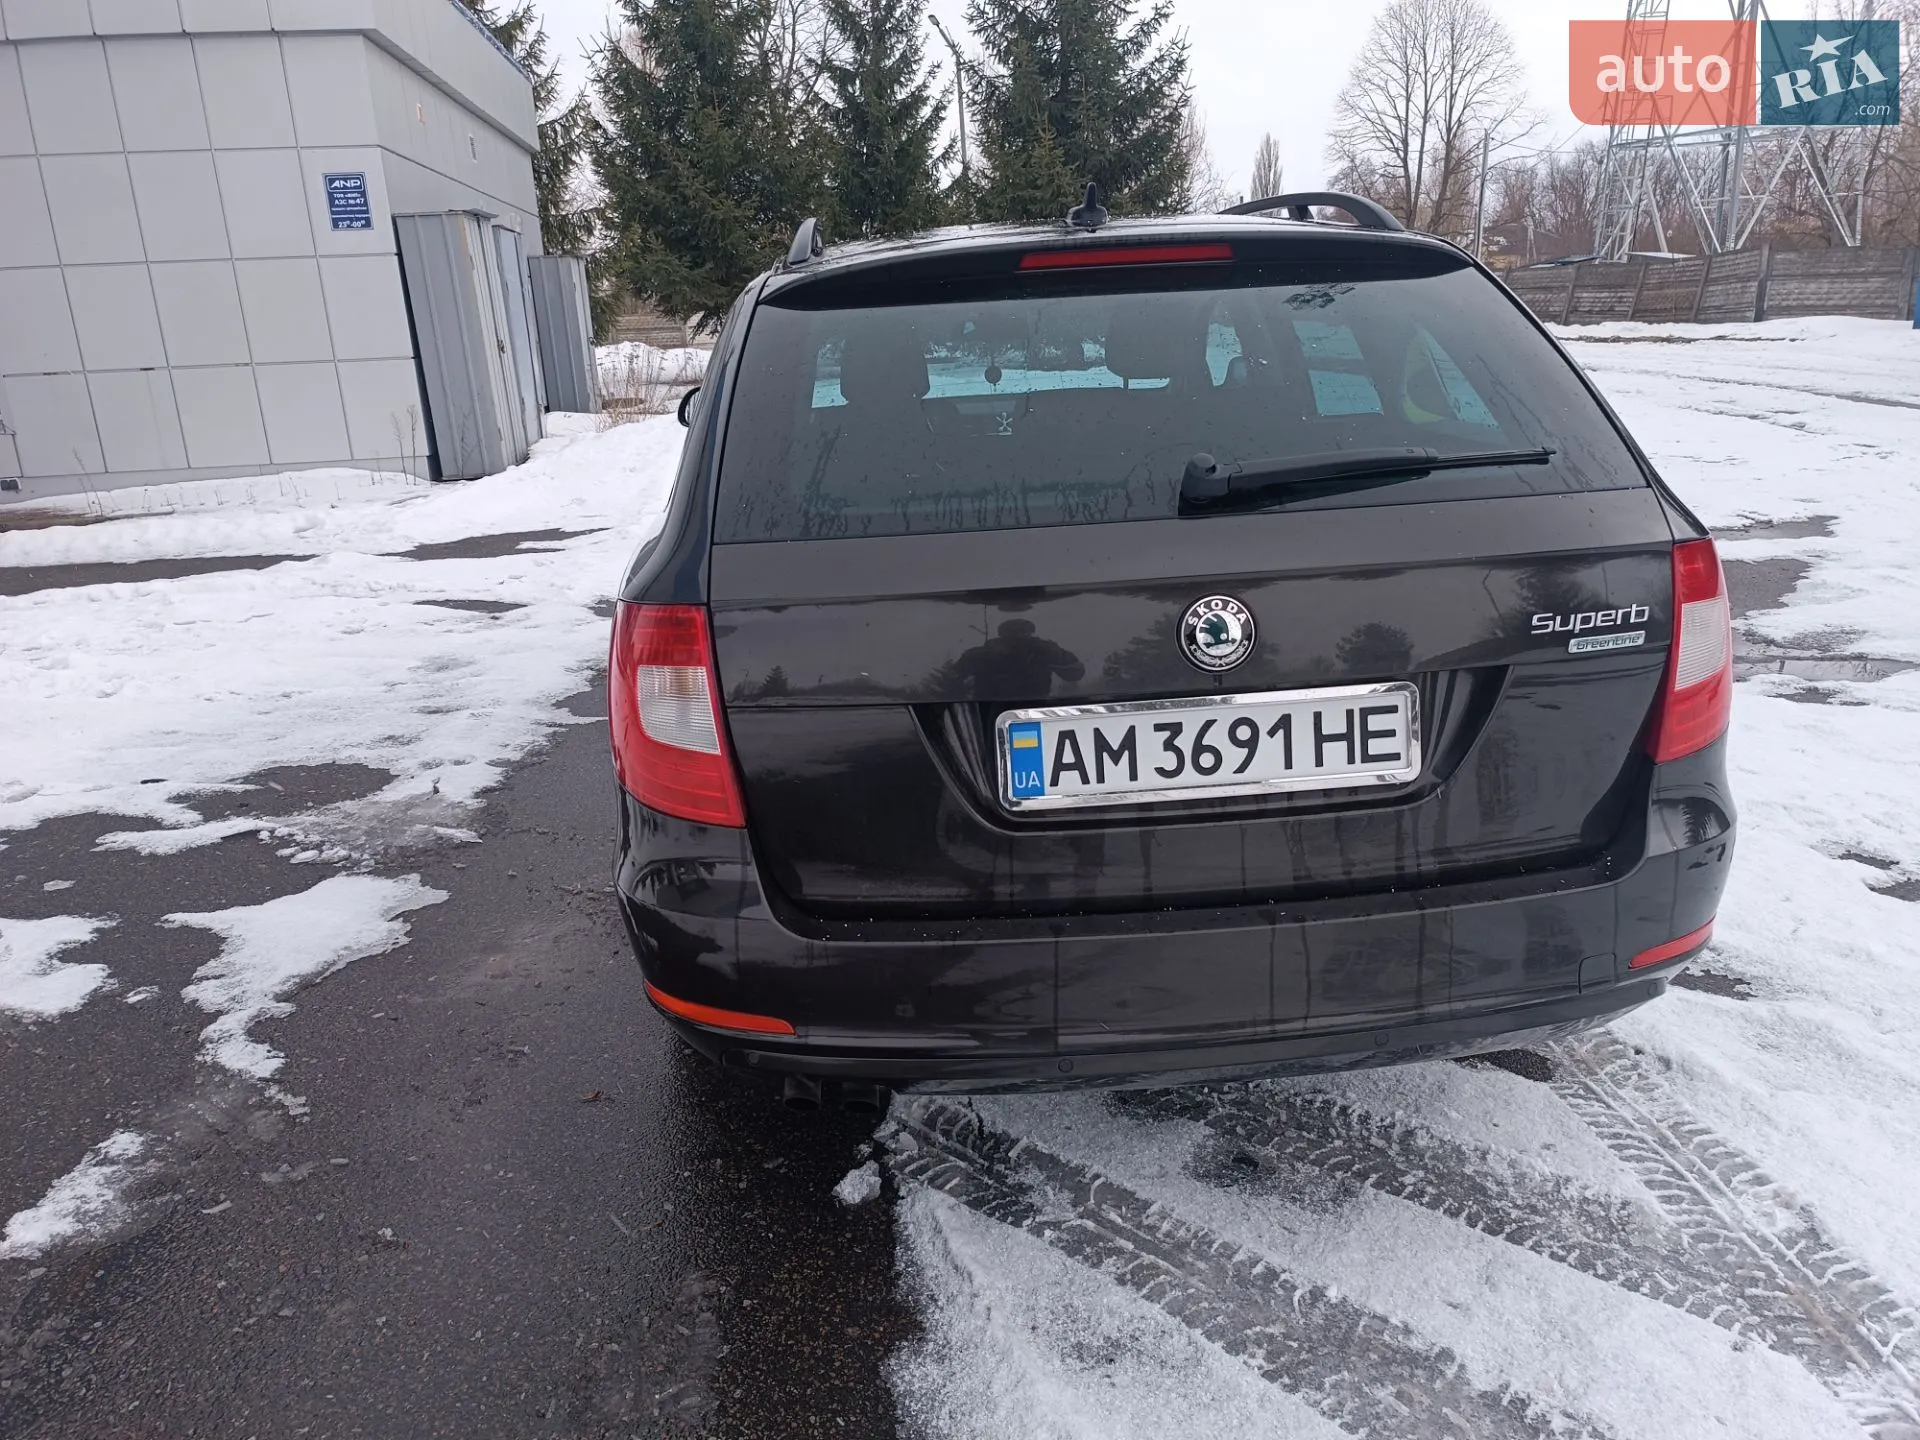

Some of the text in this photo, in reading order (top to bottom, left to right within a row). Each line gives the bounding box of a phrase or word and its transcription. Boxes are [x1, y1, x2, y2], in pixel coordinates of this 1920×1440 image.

[331, 180, 360, 188] ANP
[1187, 600, 1247, 626] SKODA
[1531, 603, 1650, 634] Superb
[1049, 704, 1401, 787] AM 3691 HE
[1014, 771, 1040, 789] UA
